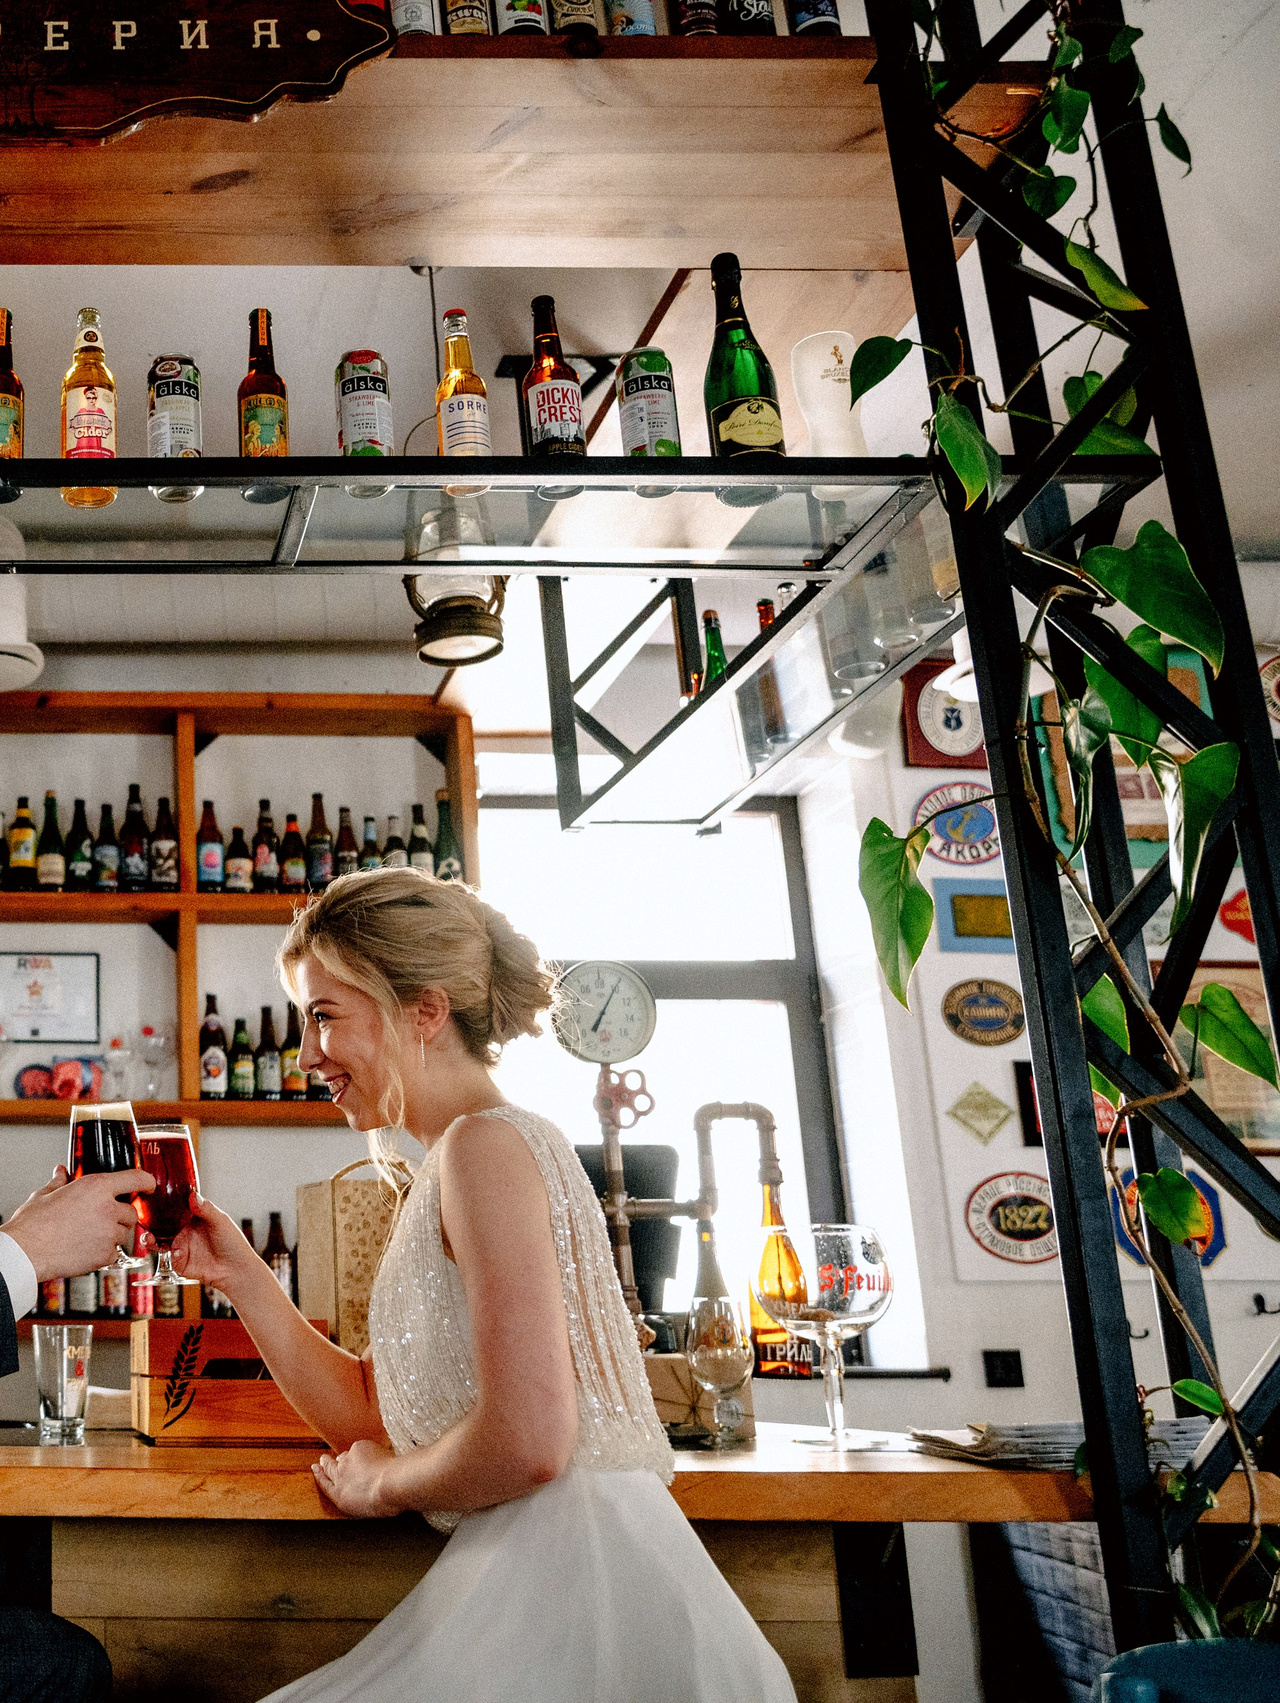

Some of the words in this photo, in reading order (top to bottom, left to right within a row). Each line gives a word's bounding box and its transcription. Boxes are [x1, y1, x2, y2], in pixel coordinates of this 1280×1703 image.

[159, 381, 197, 398] älska
[344, 376, 383, 392] älska
[628, 375, 668, 393] älska
[536, 387, 580, 408] DICKIY
[538, 405, 581, 426] CREST
[75, 427, 110, 439] Cider
[141, 1142, 160, 1154] ЕЛЬ
[998, 1204, 1048, 1231] 1827
